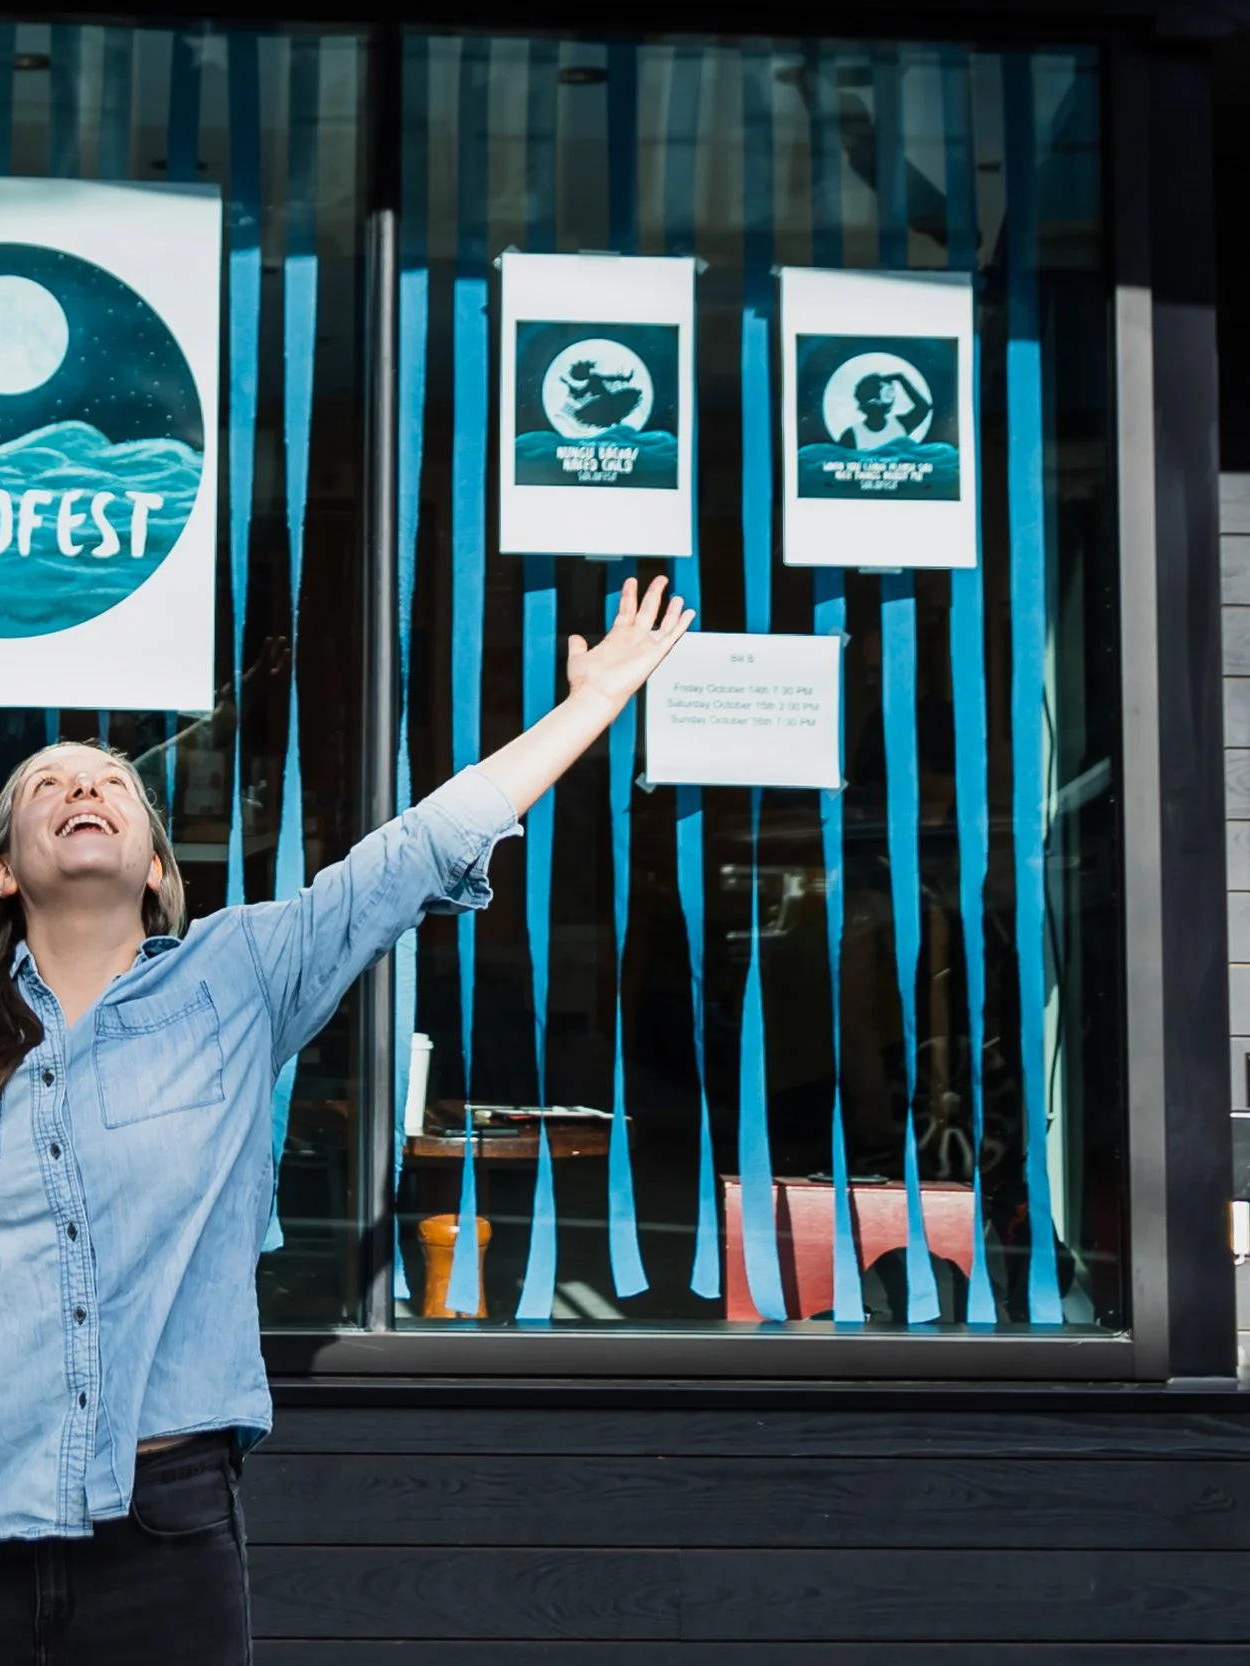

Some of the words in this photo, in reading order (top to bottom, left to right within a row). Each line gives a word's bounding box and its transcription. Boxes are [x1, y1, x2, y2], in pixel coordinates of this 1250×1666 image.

[673, 682, 704, 694] Friday
[706, 683, 745, 694] October
[796, 686, 814, 696] PM
[667, 698, 710, 711] Saturday
[713, 699, 752, 710] October
[803, 702, 820, 712] PM
[670, 714, 707, 726] Sunday
[709, 715, 748, 726] October
[799, 717, 816, 728] PM
